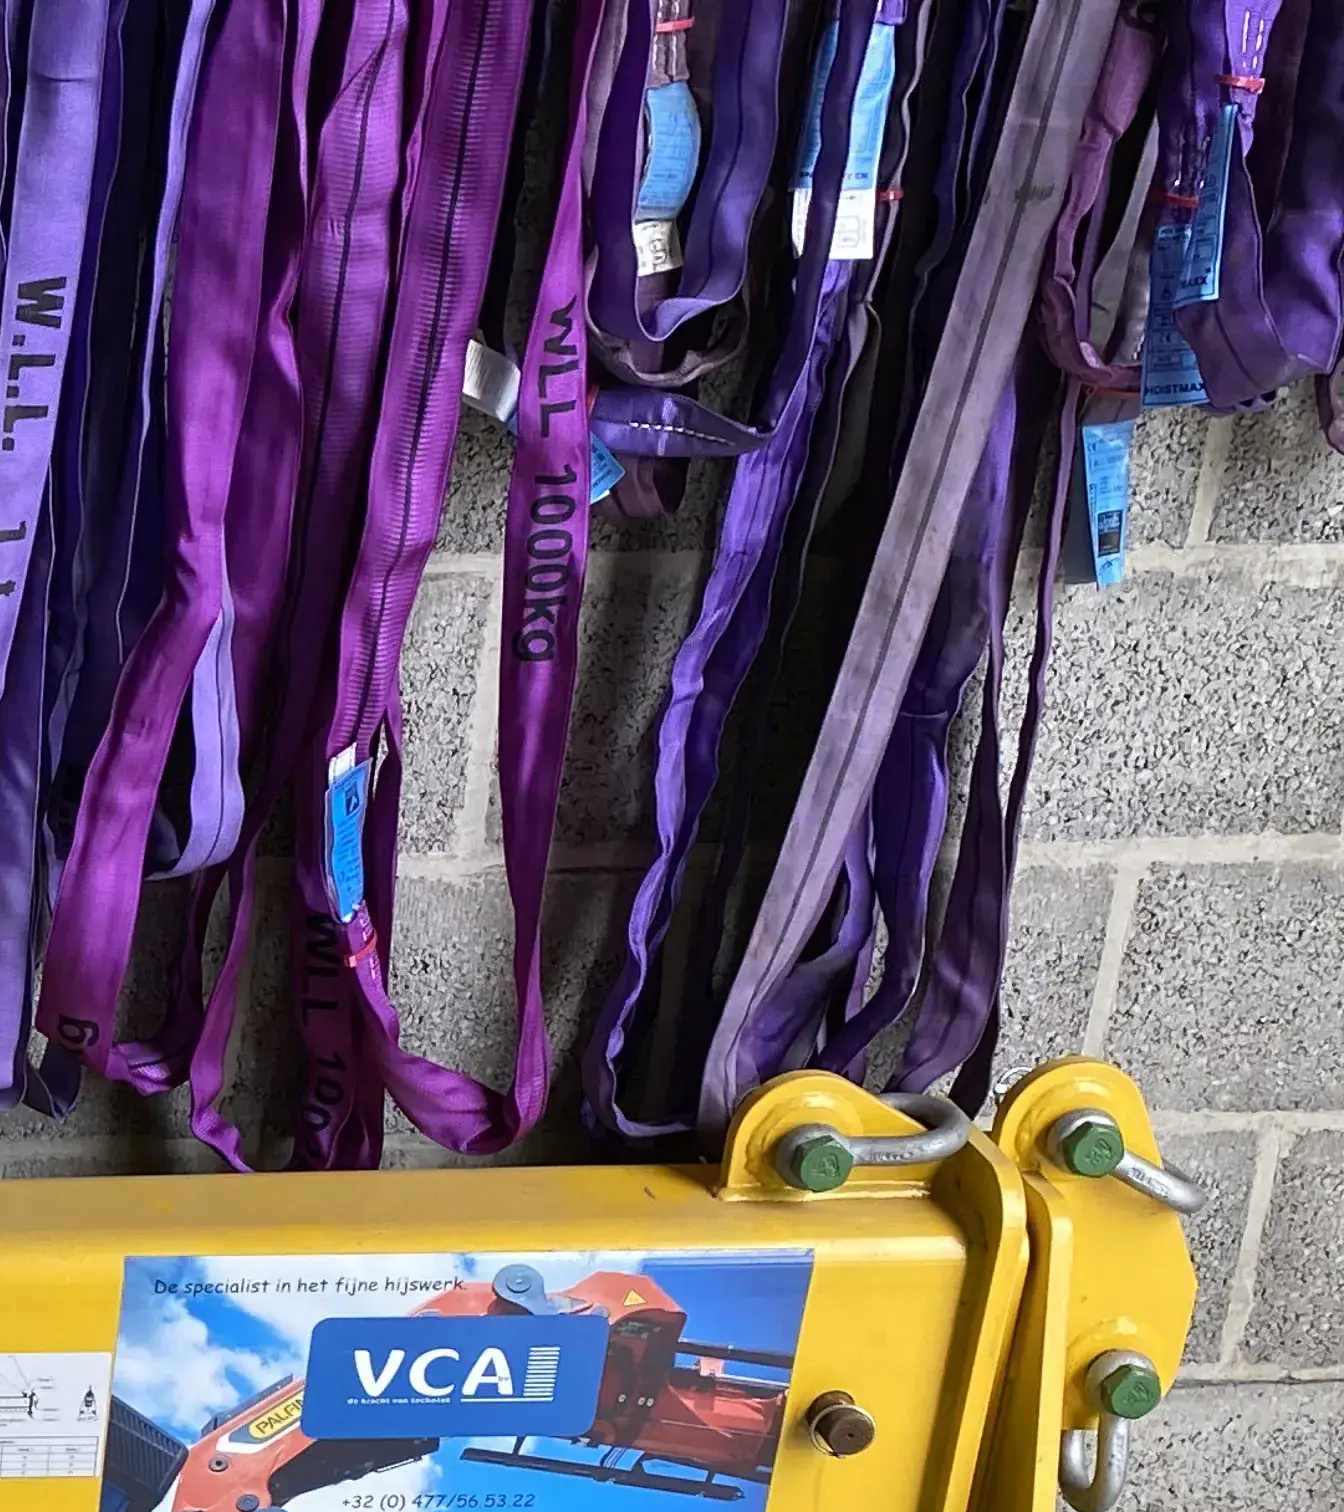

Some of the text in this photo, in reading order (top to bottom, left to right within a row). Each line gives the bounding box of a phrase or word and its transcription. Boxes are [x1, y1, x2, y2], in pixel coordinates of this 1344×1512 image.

[2, 275, 68, 451] W.L.L.
[515, 294, 580, 662] WLL 1000kg
[154, 1278, 178, 1295] De
[184, 1277, 271, 1297] specialist
[276, 1277, 292, 1293] in
[296, 1277, 328, 1293] het
[335, 1276, 379, 1296] fijne
[354, 1347, 514, 1397] VCA
[342, 1494, 374, 1509] +32
[380, 1494, 406, 1511] (0)
